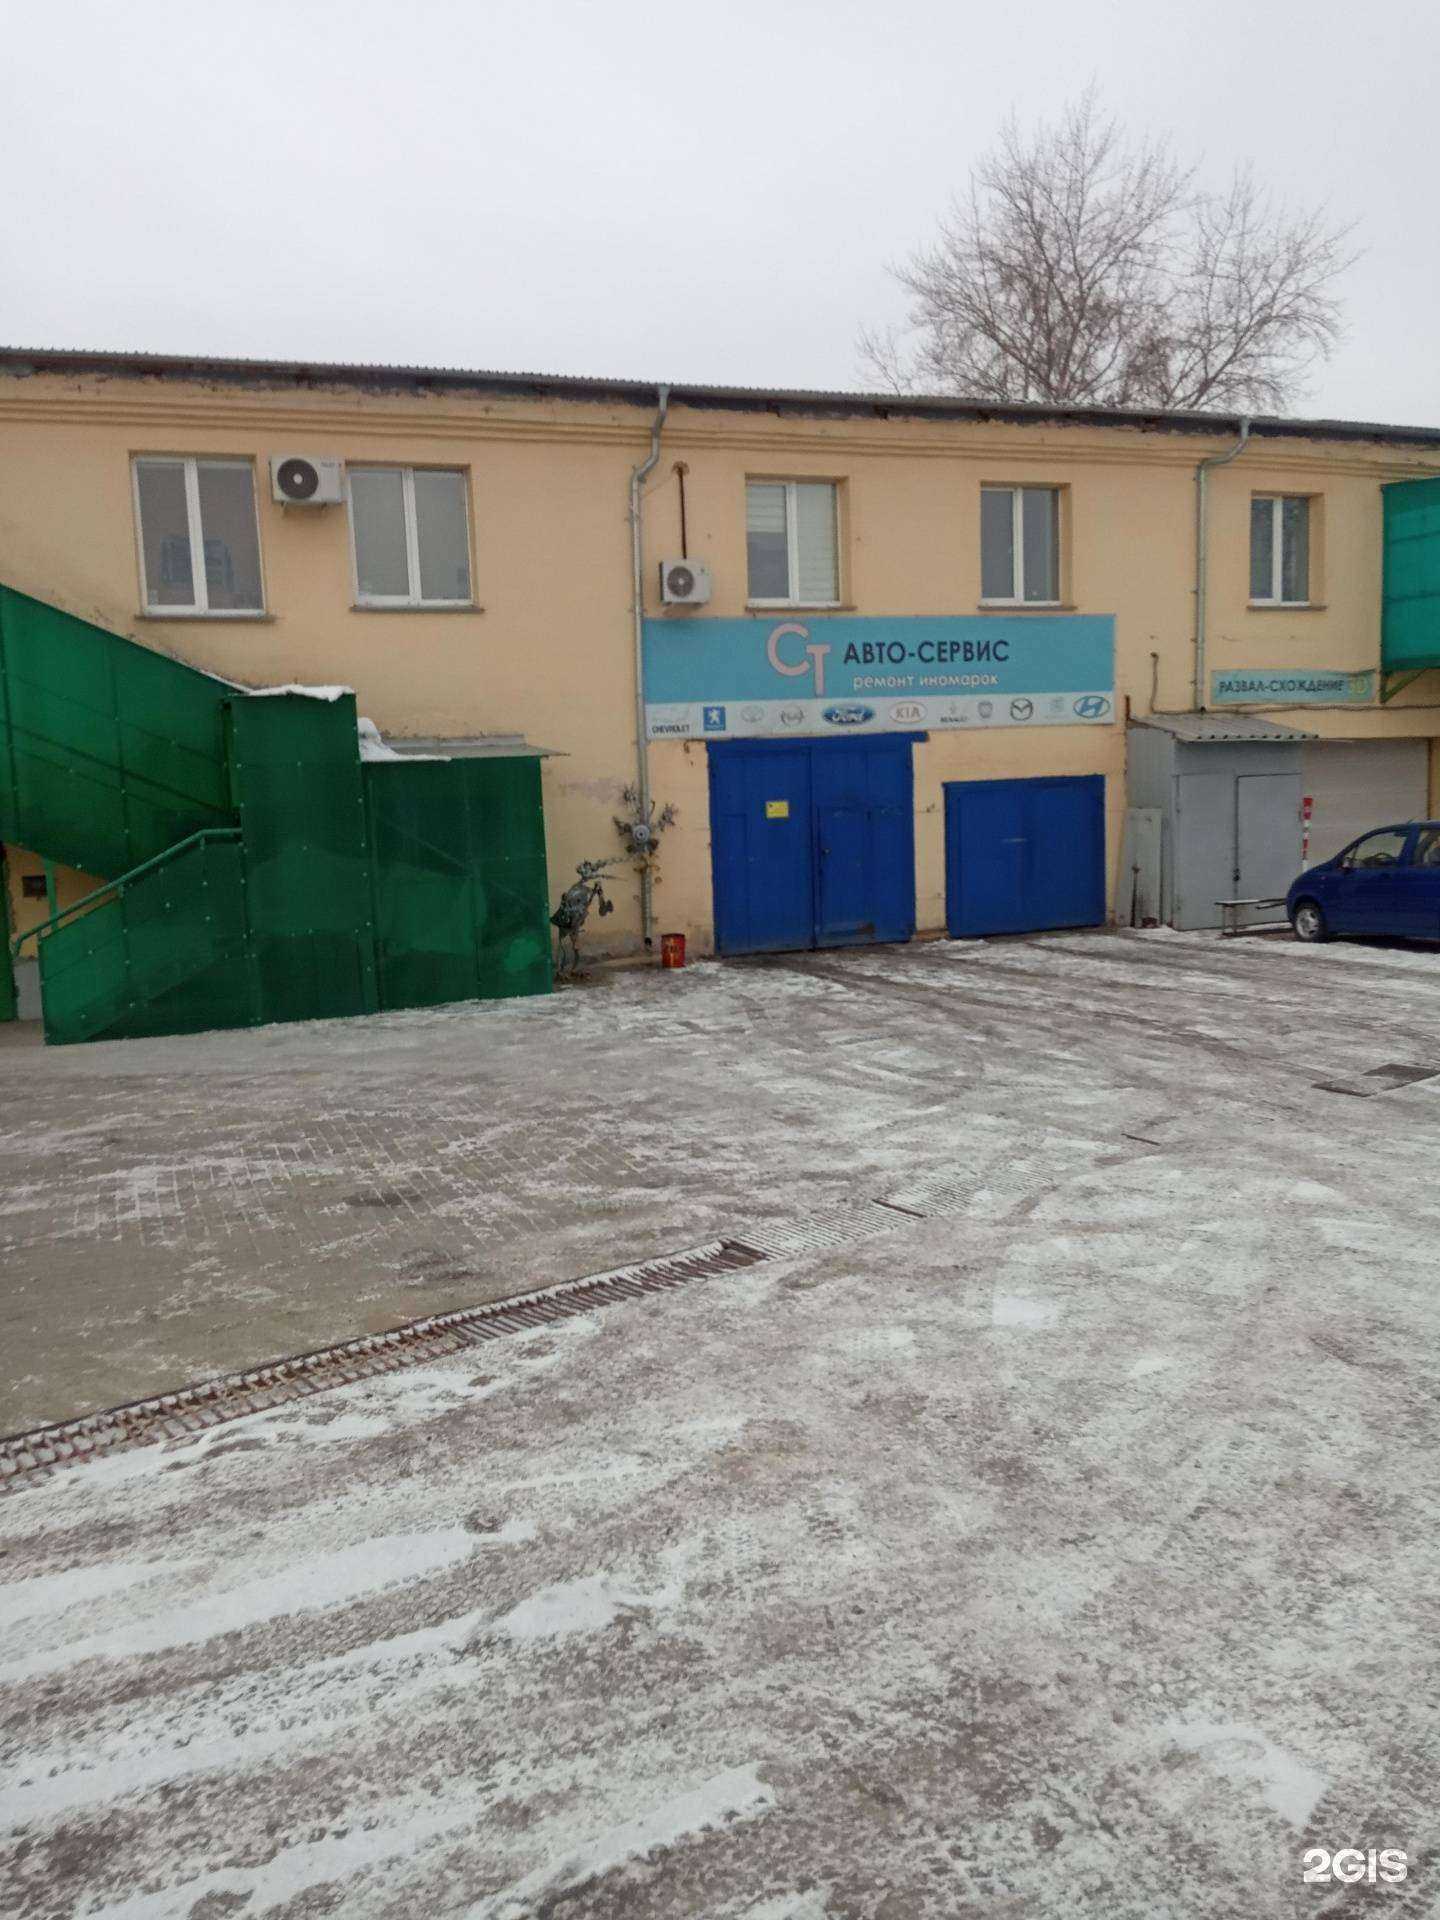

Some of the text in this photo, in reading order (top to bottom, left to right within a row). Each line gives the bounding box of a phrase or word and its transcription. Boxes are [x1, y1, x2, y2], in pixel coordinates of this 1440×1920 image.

[843, 640, 1009, 664] АВТО-СЕРВИС
[852, 673, 998, 690] ремонт иномарок
[1218, 680, 1344, 693] РАЗВАЛ-СХОЖДЕНИЕ
[894, 706, 921, 719] KIA
[651, 724, 691, 734] CHEVROLET
